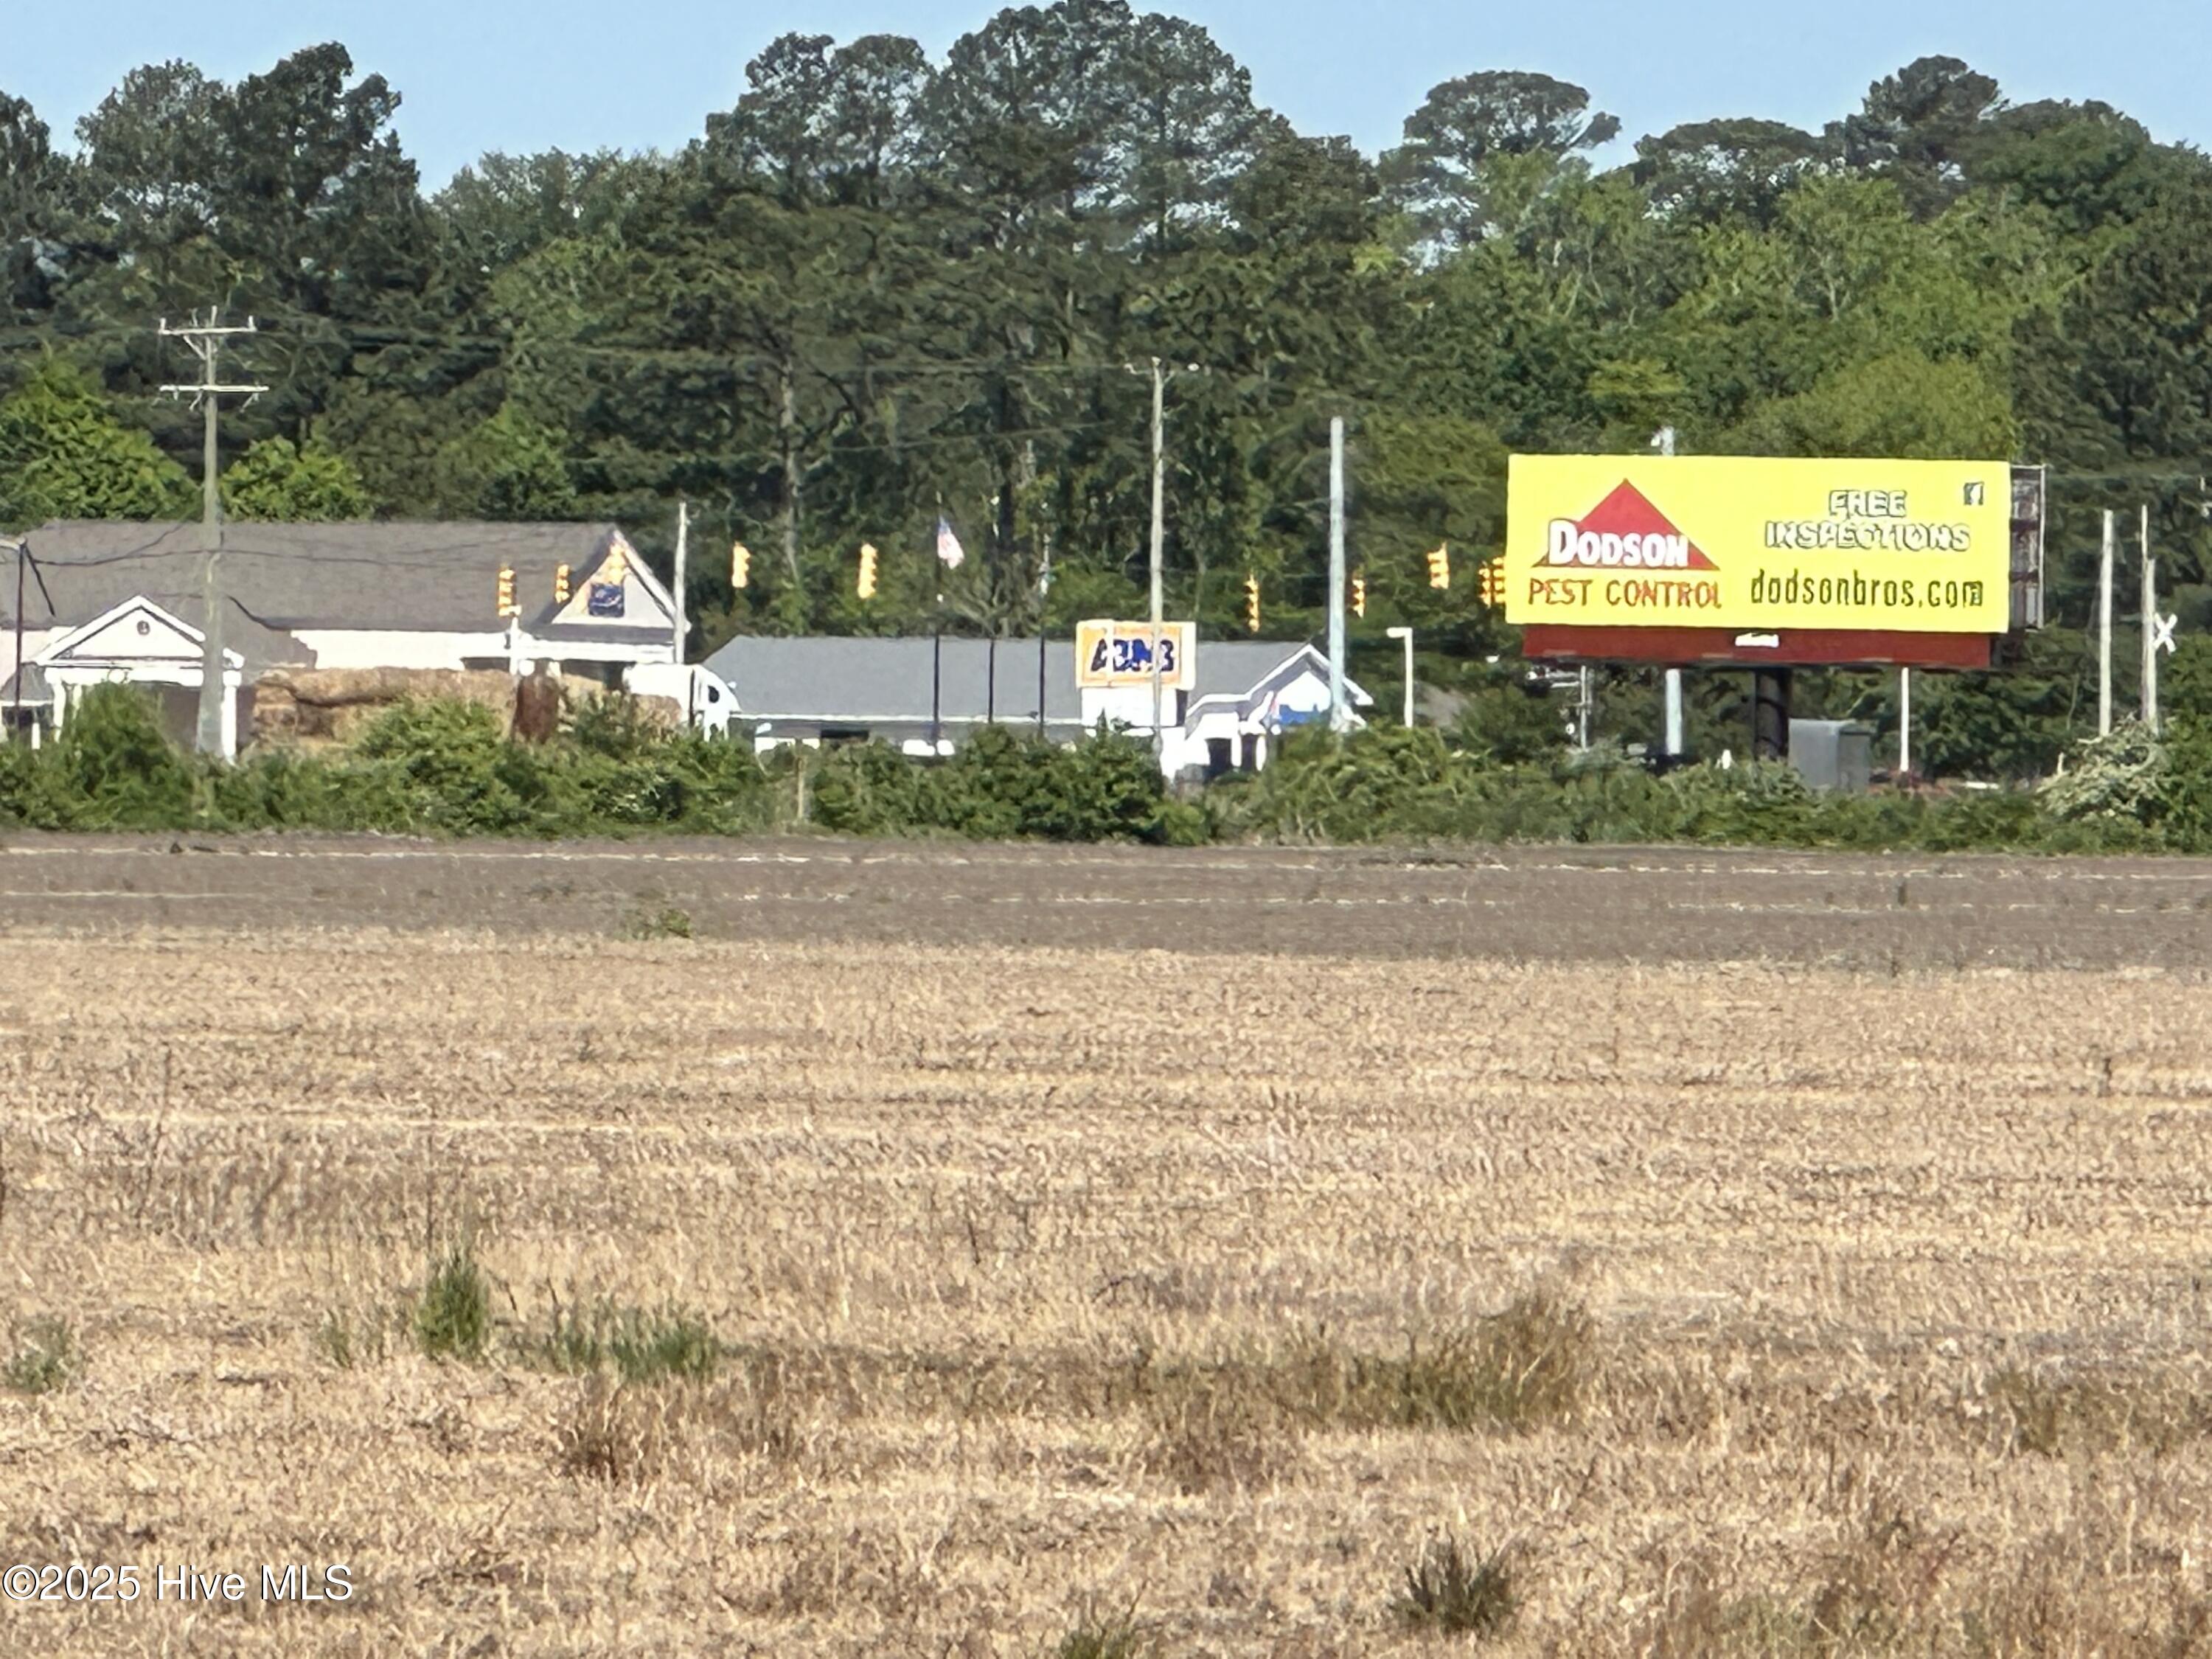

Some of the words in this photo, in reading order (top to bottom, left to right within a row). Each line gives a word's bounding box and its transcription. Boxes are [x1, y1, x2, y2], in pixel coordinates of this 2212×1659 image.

[1829, 490, 1907, 518] FREE
[1548, 518, 1689, 567] DODSON
[1765, 520, 1971, 552] INSPECTIONS
[1528, 577, 1593, 607] PEST
[1606, 580, 1722, 610] CONTROL
[1750, 568, 1983, 608] dodsonbros.com
